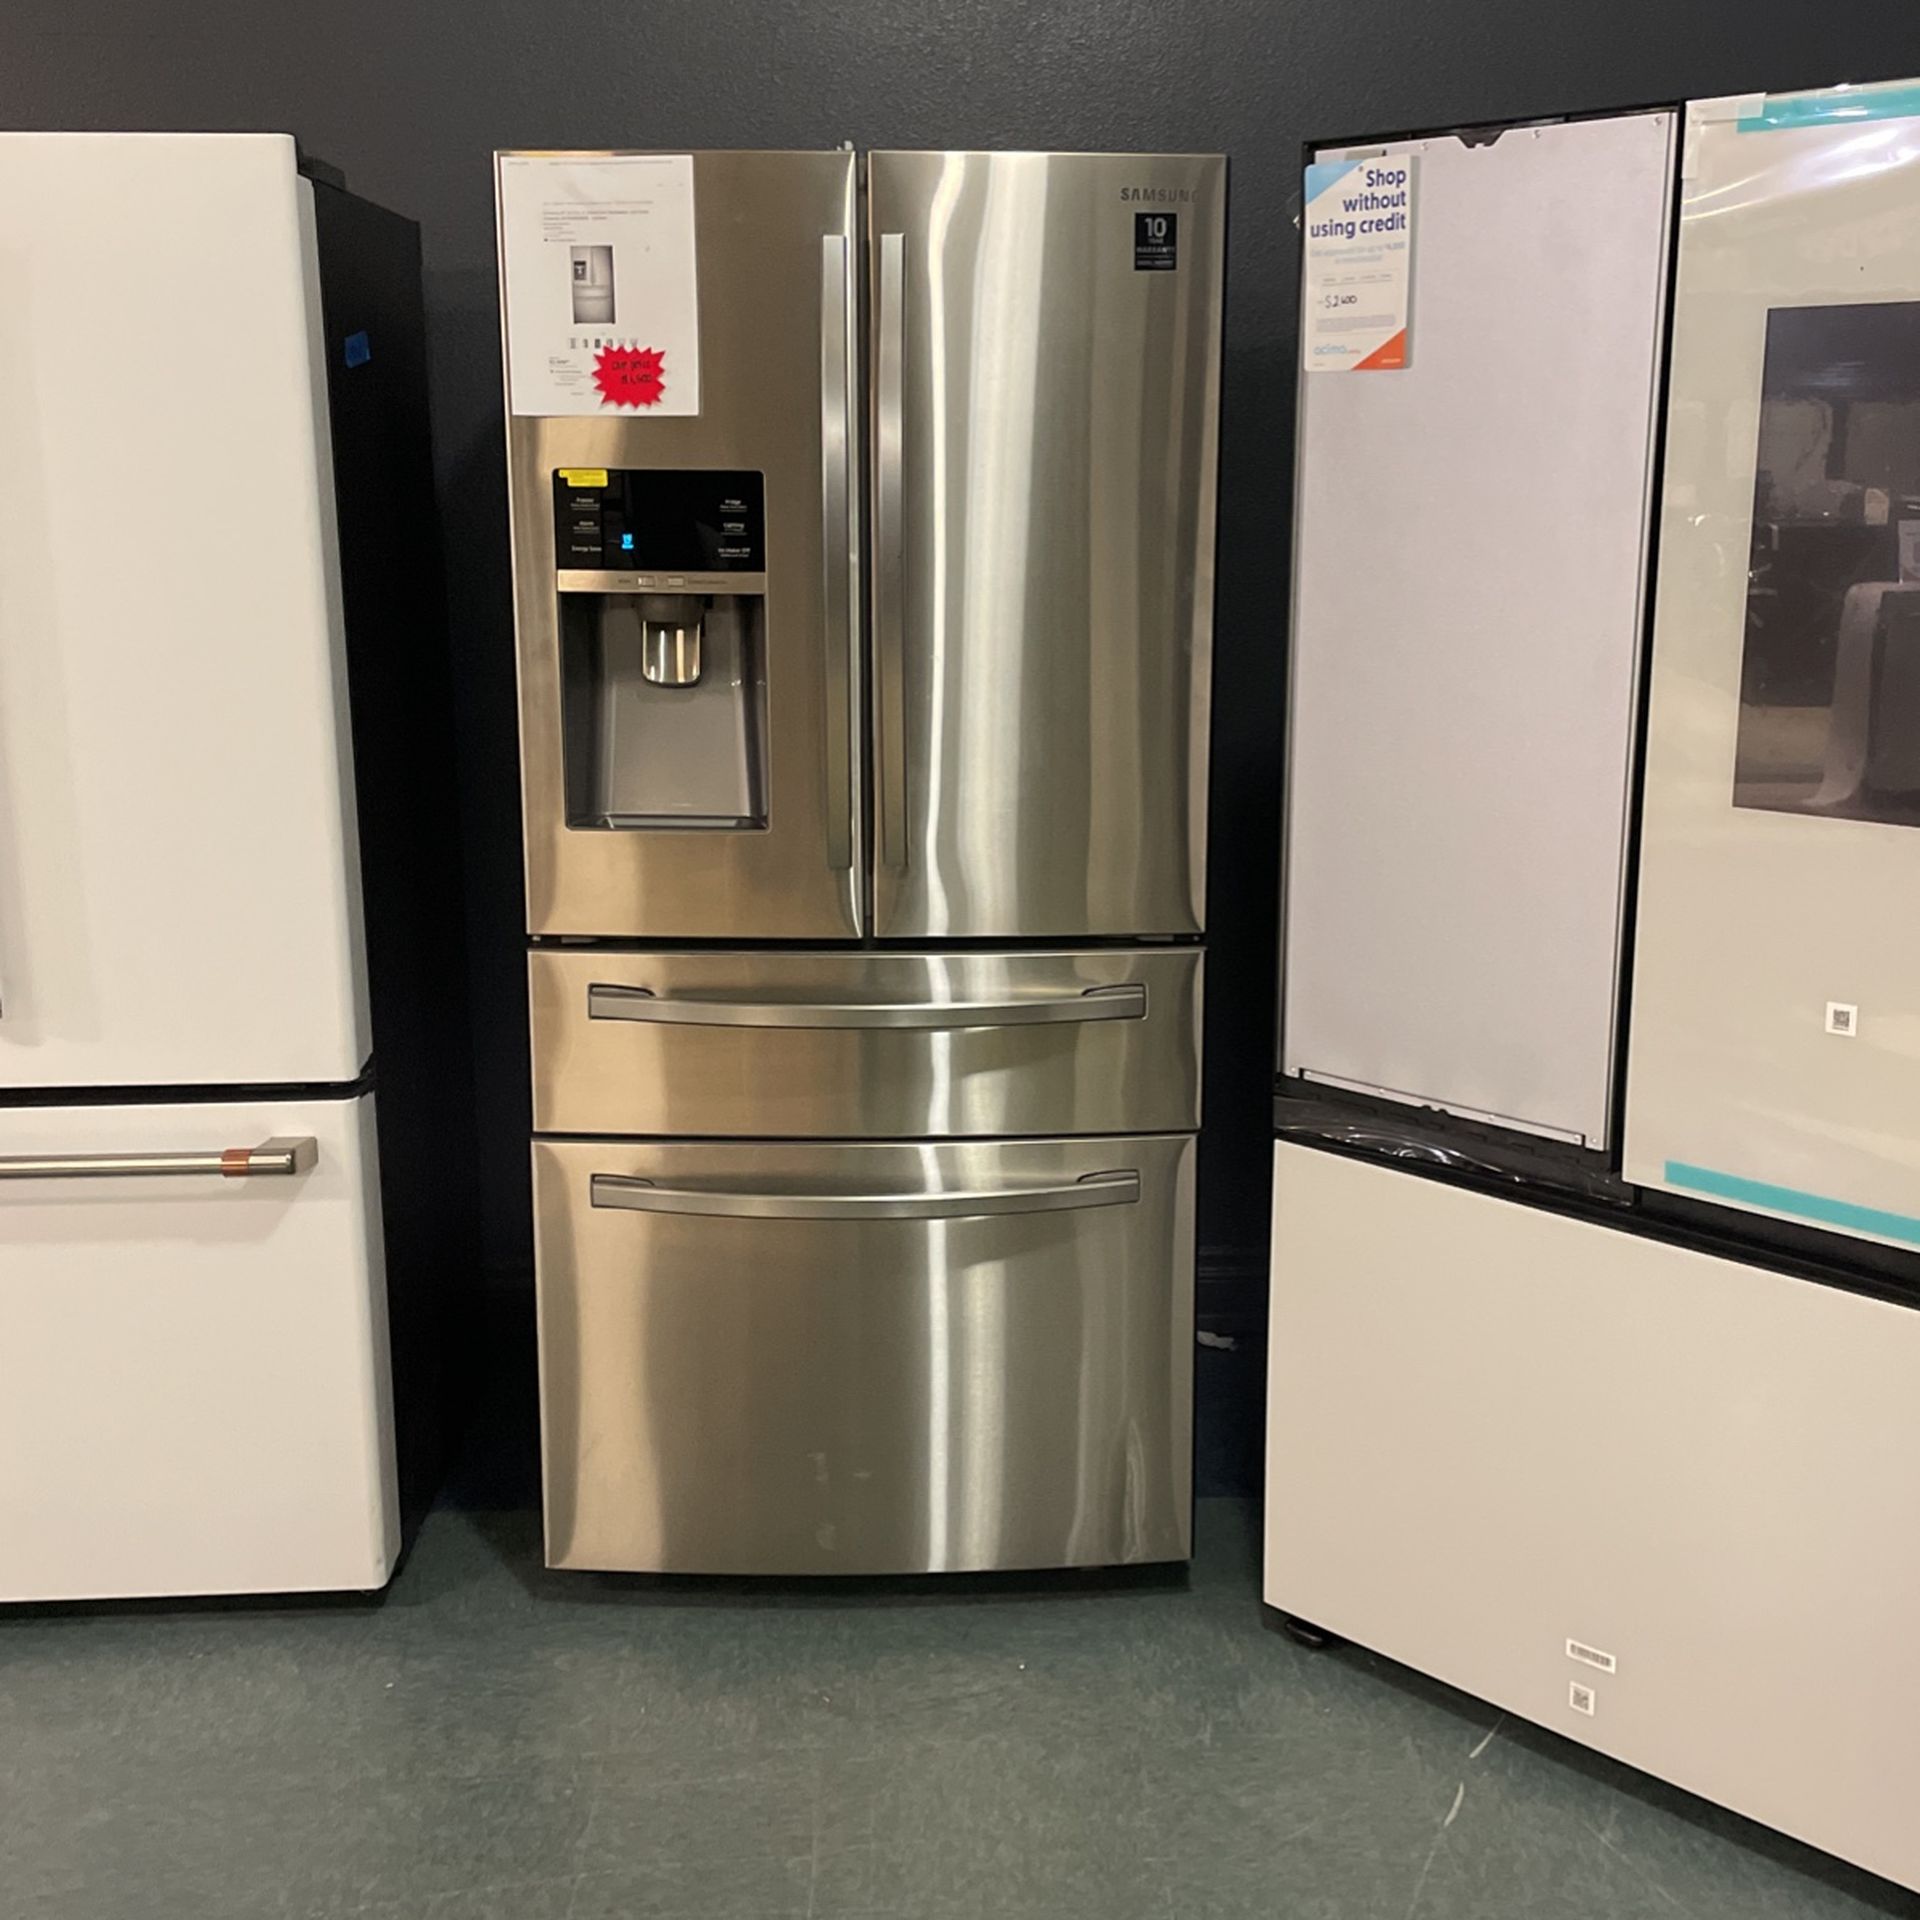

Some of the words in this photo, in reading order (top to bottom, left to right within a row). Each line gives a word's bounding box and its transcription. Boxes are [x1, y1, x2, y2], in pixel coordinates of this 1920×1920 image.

[1366, 169, 1406, 188] Shop
[1343, 191, 1406, 212] without
[1145, 217, 1167, 237] 10
[1310, 219, 1355, 239] using
[1360, 212, 1406, 233] credit
